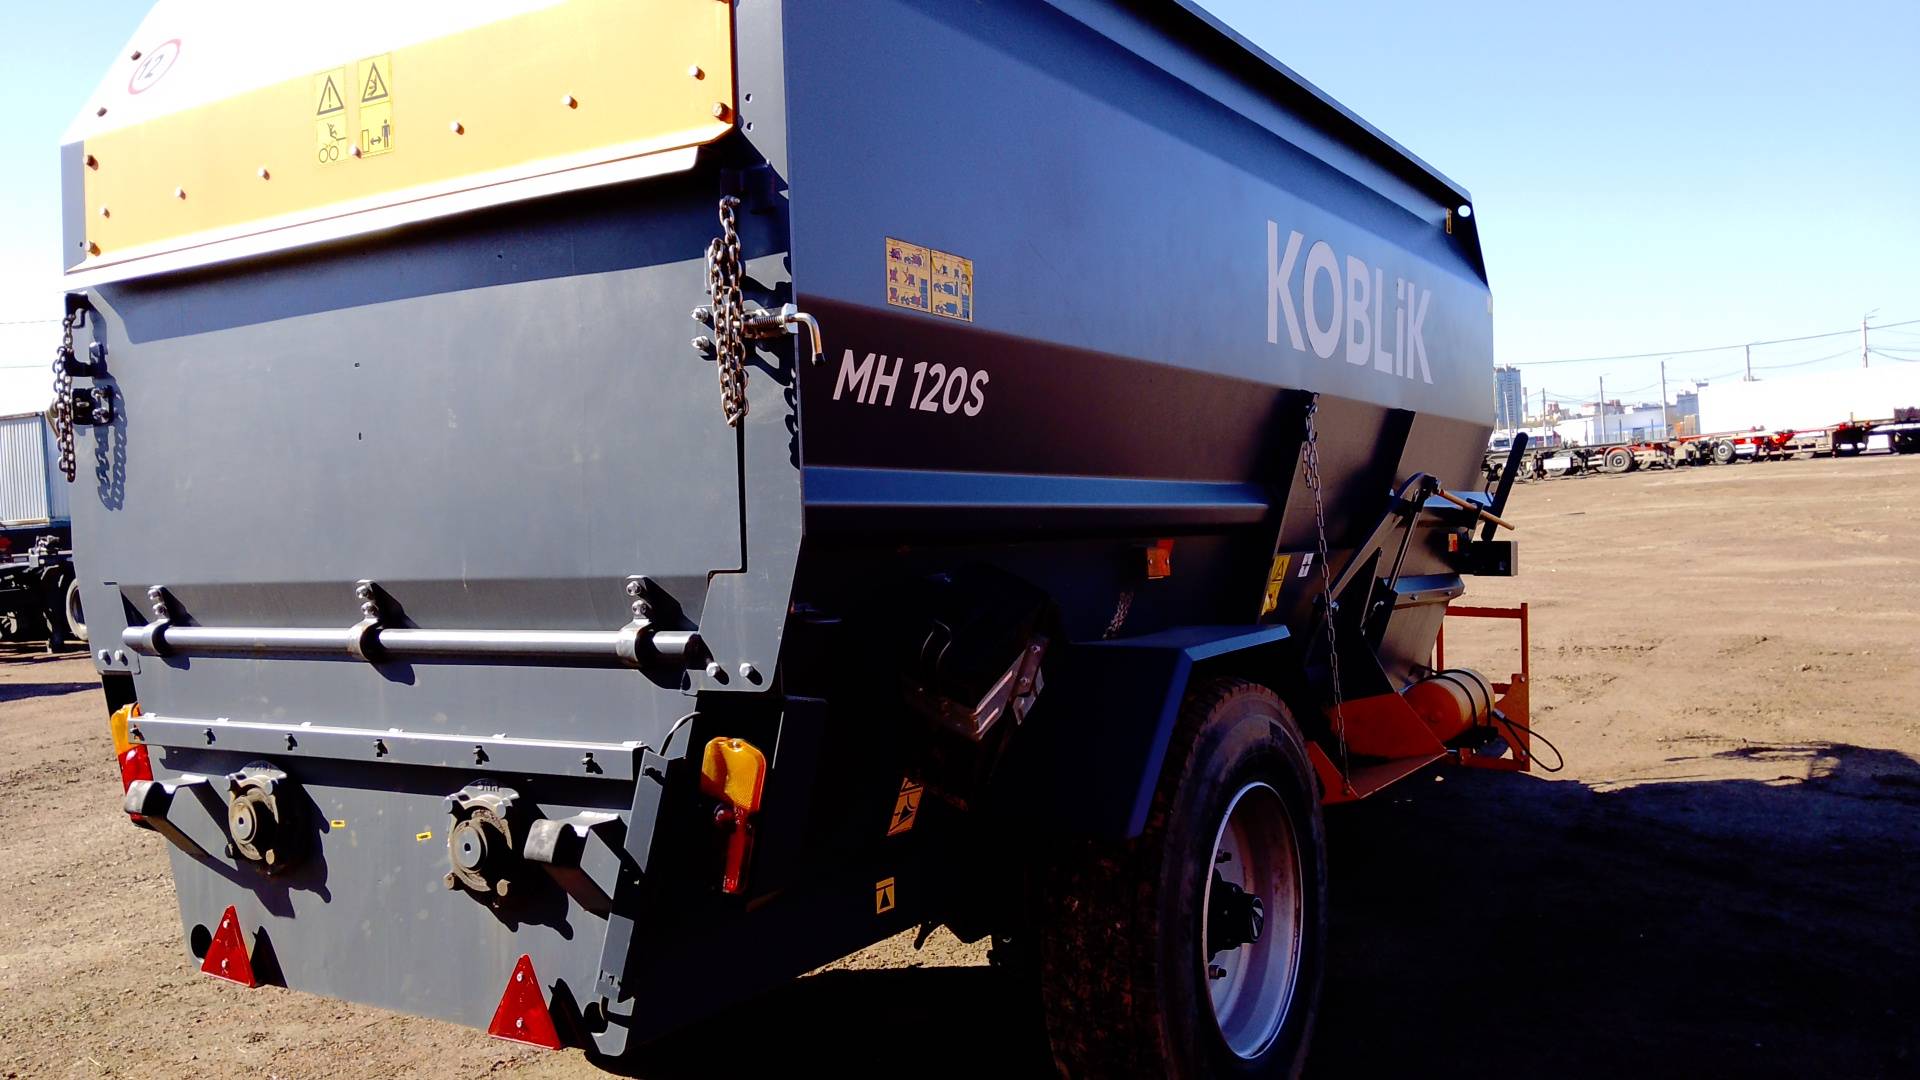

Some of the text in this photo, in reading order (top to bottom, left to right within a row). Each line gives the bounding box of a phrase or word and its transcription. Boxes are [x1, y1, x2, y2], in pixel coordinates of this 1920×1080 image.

[137, 54, 164, 80] 12
[833, 349, 990, 417] MH 120S
